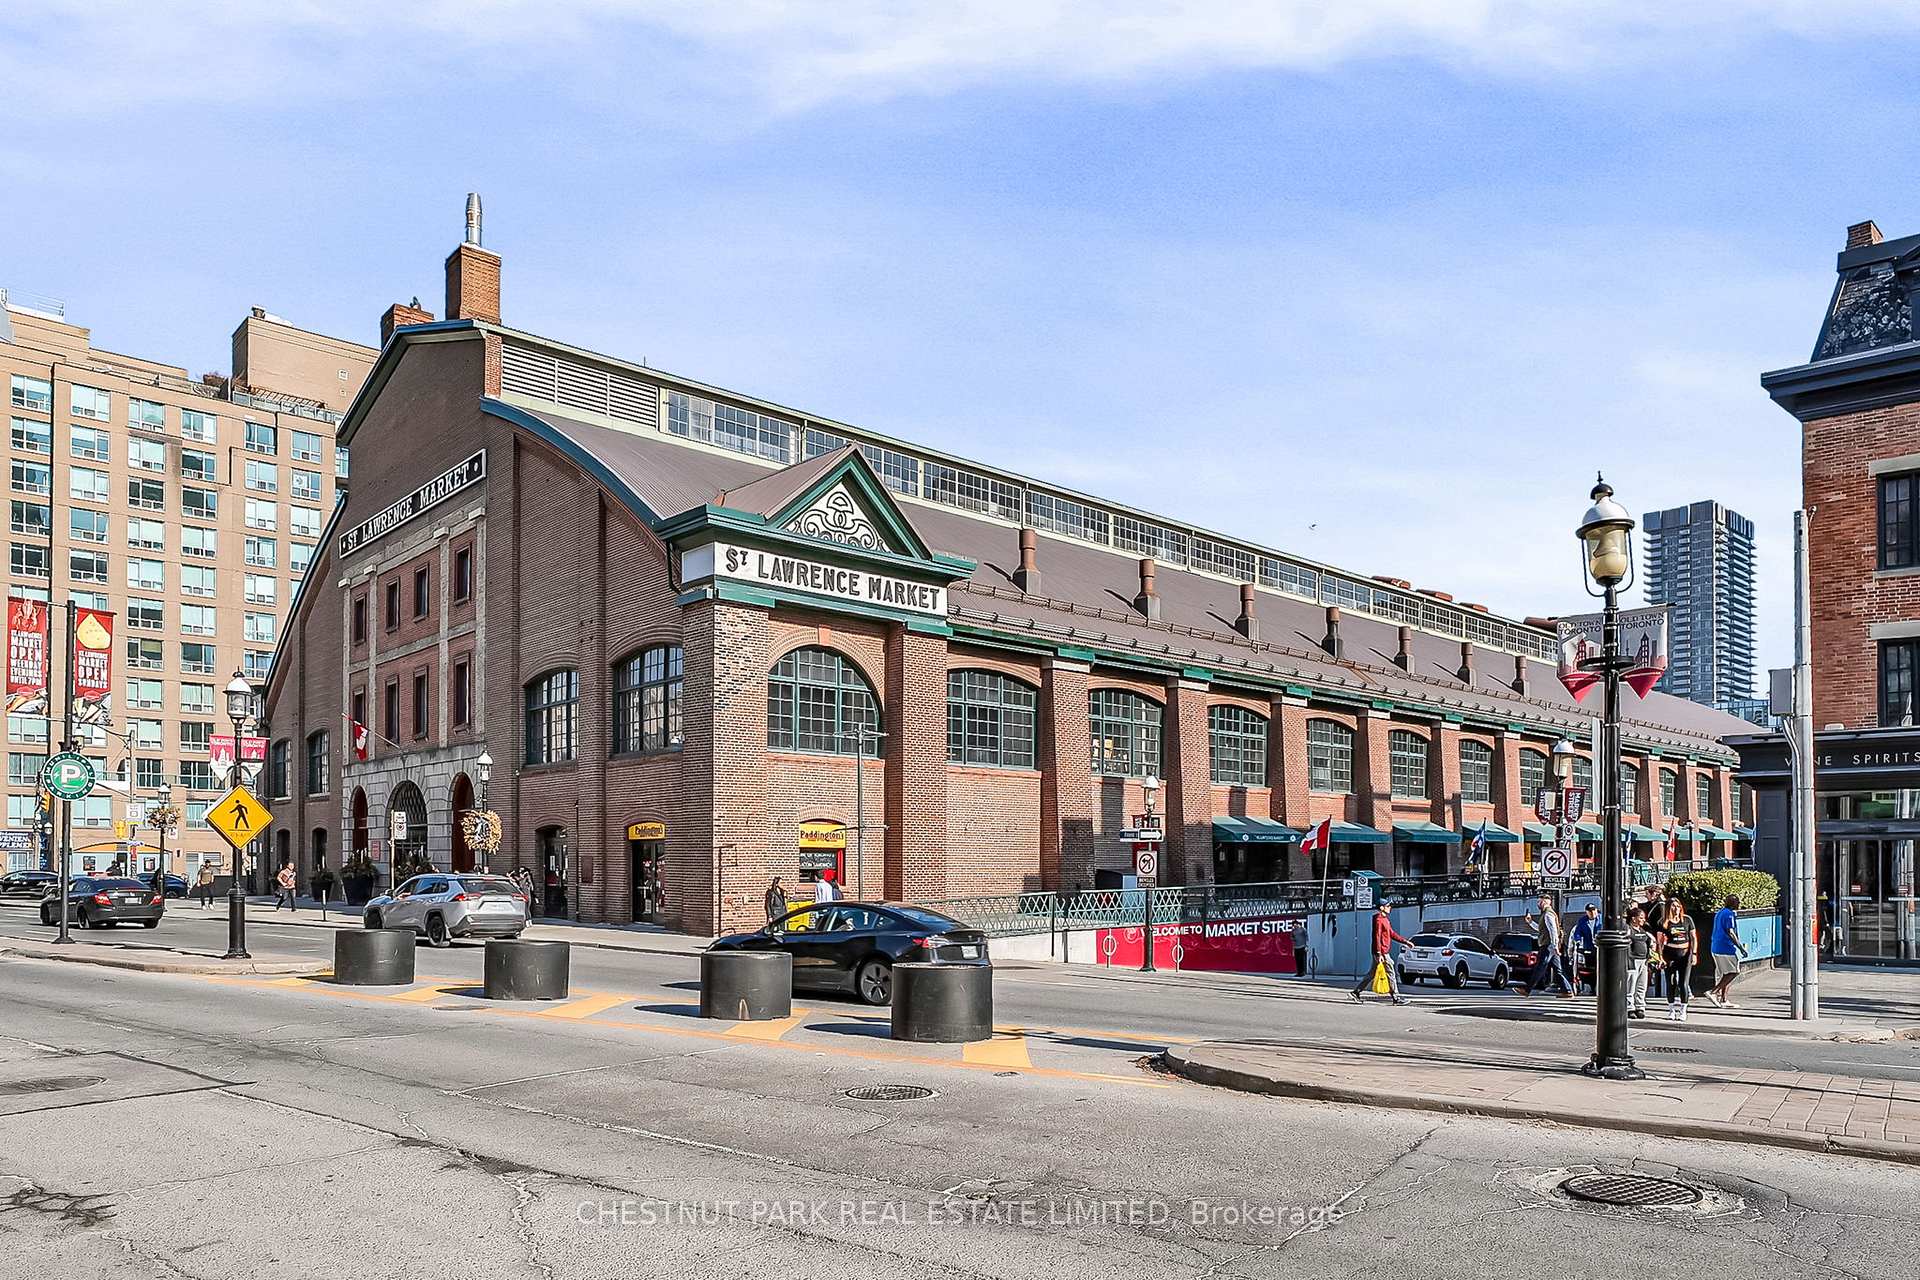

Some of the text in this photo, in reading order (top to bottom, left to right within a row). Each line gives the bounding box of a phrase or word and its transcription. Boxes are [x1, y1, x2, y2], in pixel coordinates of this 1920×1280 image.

[362, 497, 412, 542] LAWRENCE
[419, 462, 469, 508] MARKET
[758, 554, 860, 596] LAWRENCE
[868, 578, 940, 610] MARKET
[1640, 612, 1664, 620] TOWN
[1559, 626, 1601, 635] TORONTO
[1620, 618, 1664, 630] TORONTO
[11, 637, 42, 649] MARKET
[11, 645, 42, 661] OPEN
[78, 656, 107, 668] MARKET
[78, 665, 107, 680] OPEN
[1785, 751, 1920, 767] VNE SPIRITS
[61, 764, 81, 785] P
[1189, 925, 1202, 934] TO
[1205, 921, 1260, 938] MARKET
[1261, 919, 1307, 934] STRET
